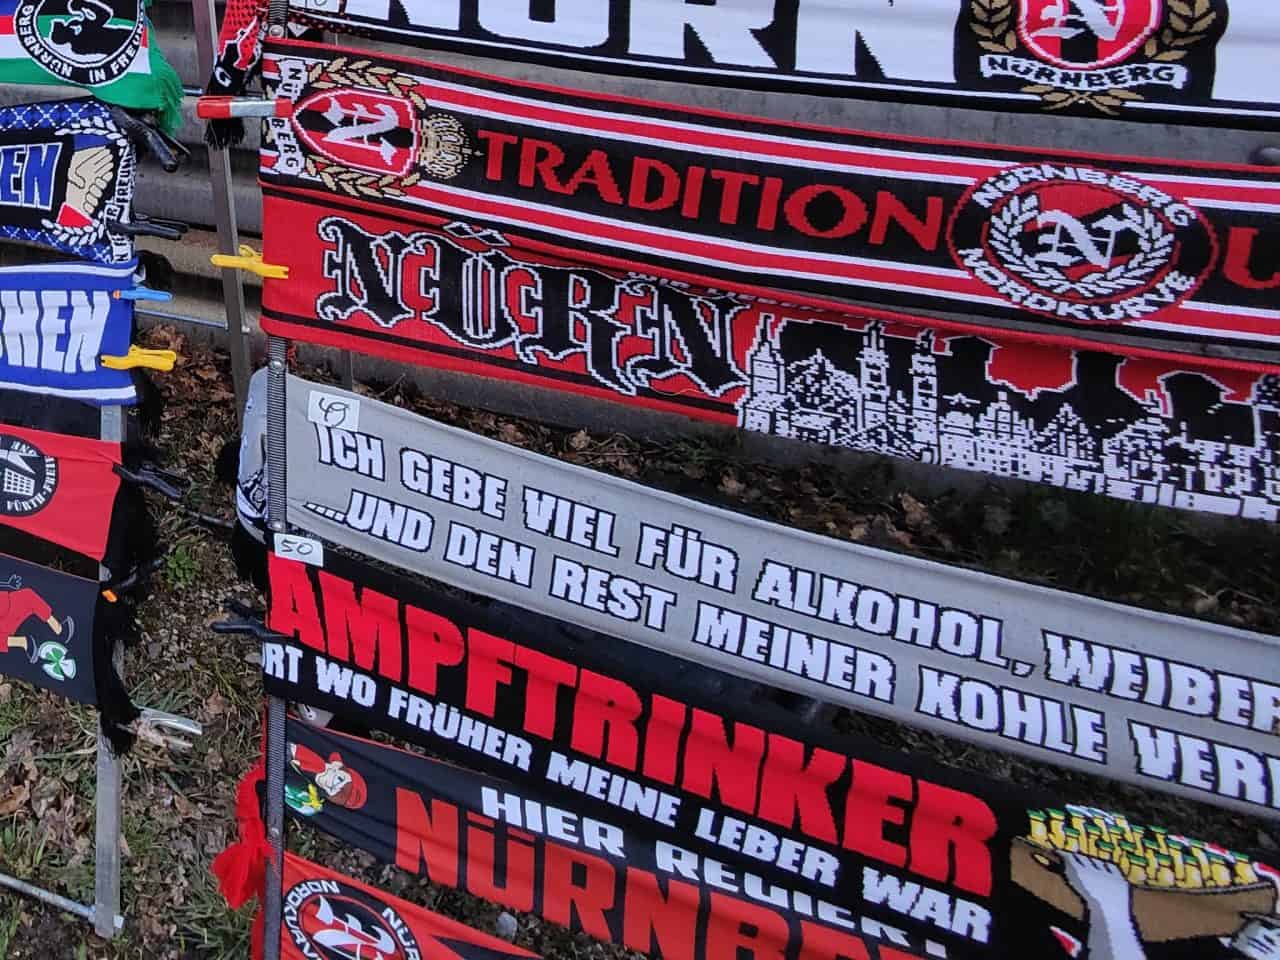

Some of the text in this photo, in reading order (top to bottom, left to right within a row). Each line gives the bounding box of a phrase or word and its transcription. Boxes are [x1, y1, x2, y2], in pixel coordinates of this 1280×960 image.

[19, 5, 73, 77] NÜRNBERG
[89, 69, 106, 83] IN
[988, 54, 1176, 88] NÜRNBERG
[477, 129, 943, 252] TRADITION
[973, 162, 1197, 226] NÜRNBERG
[958, 247, 1197, 321] NORDKURVE
[315, 421, 386, 481] ICH
[399, 447, 508, 521] GEBE
[521, 486, 622, 557] VIEL
[637, 523, 739, 595] FÜR
[752, 559, 1035, 677] ALKOHOL,
[444, 521, 535, 588] DEN
[550, 556, 677, 633] REST
[693, 599, 897, 704] MEINER
[917, 664, 1108, 765] KOHLE
[315, 657, 992, 944] WO FRÜHER MEINE LEBER WAR
[481, 786, 625, 859] HIER
